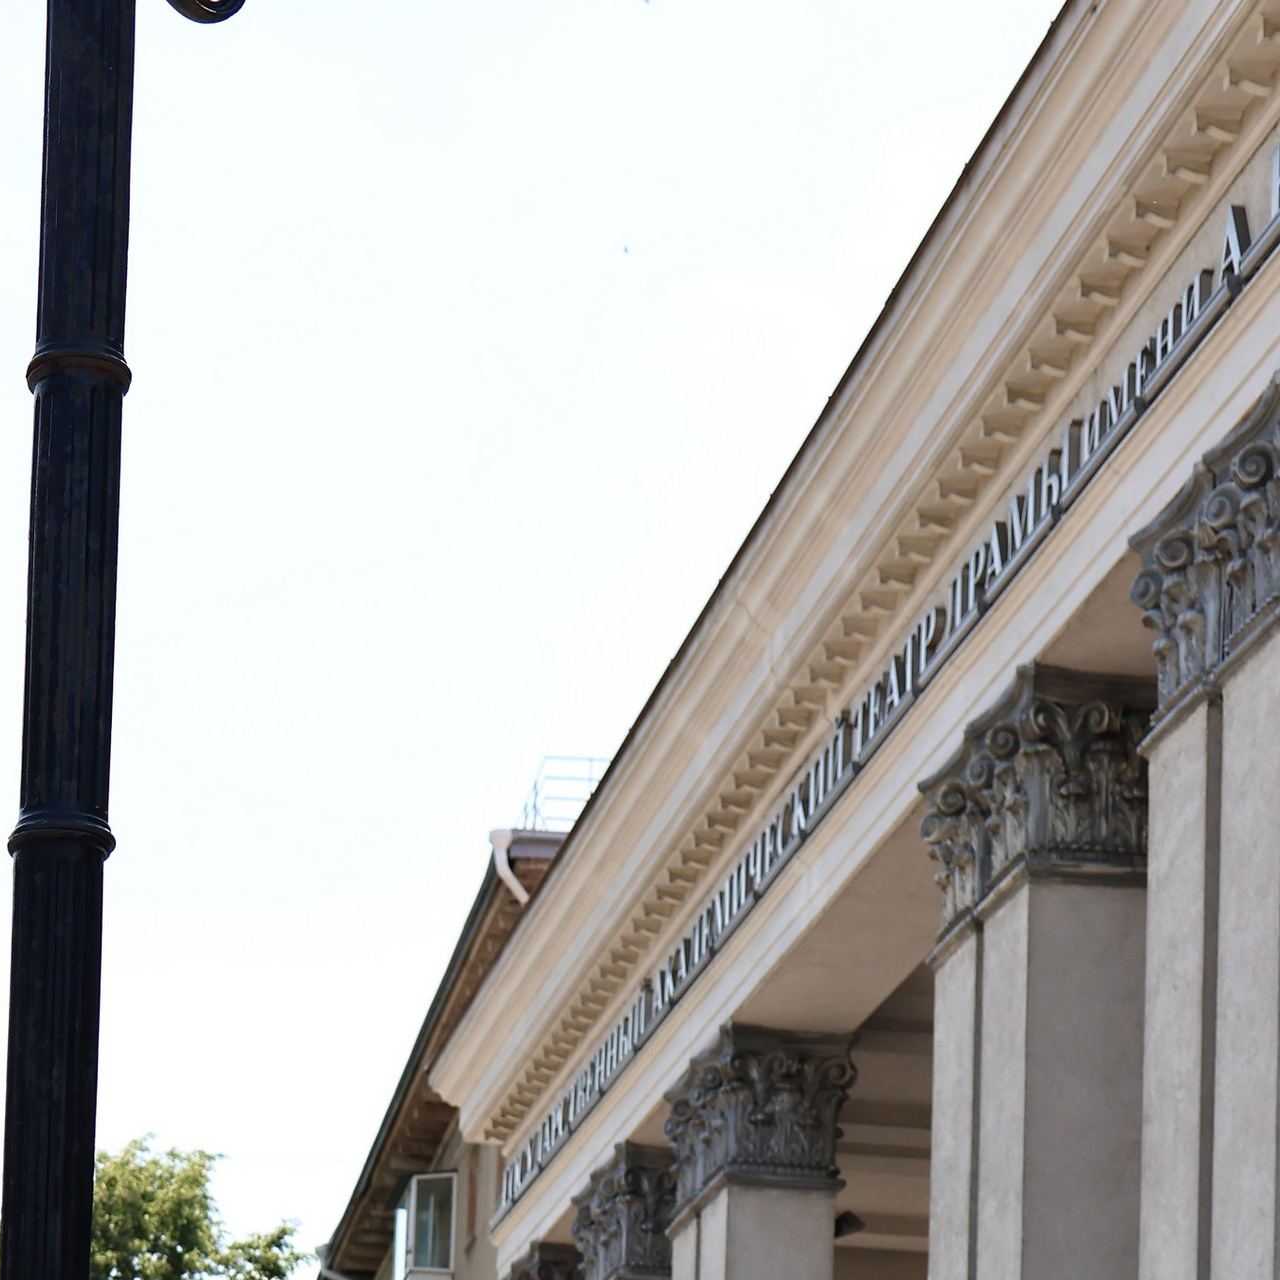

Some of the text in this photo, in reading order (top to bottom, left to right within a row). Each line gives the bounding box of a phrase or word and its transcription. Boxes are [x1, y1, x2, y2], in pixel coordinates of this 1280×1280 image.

[653, 709, 851, 1018] АКАДЕМИЧЕСКИЙ
[854, 606, 944, 760] ТЕАТР
[944, 419, 1077, 638] ДРАМЫ
[1084, 268, 1211, 460] ИМЕНИ
